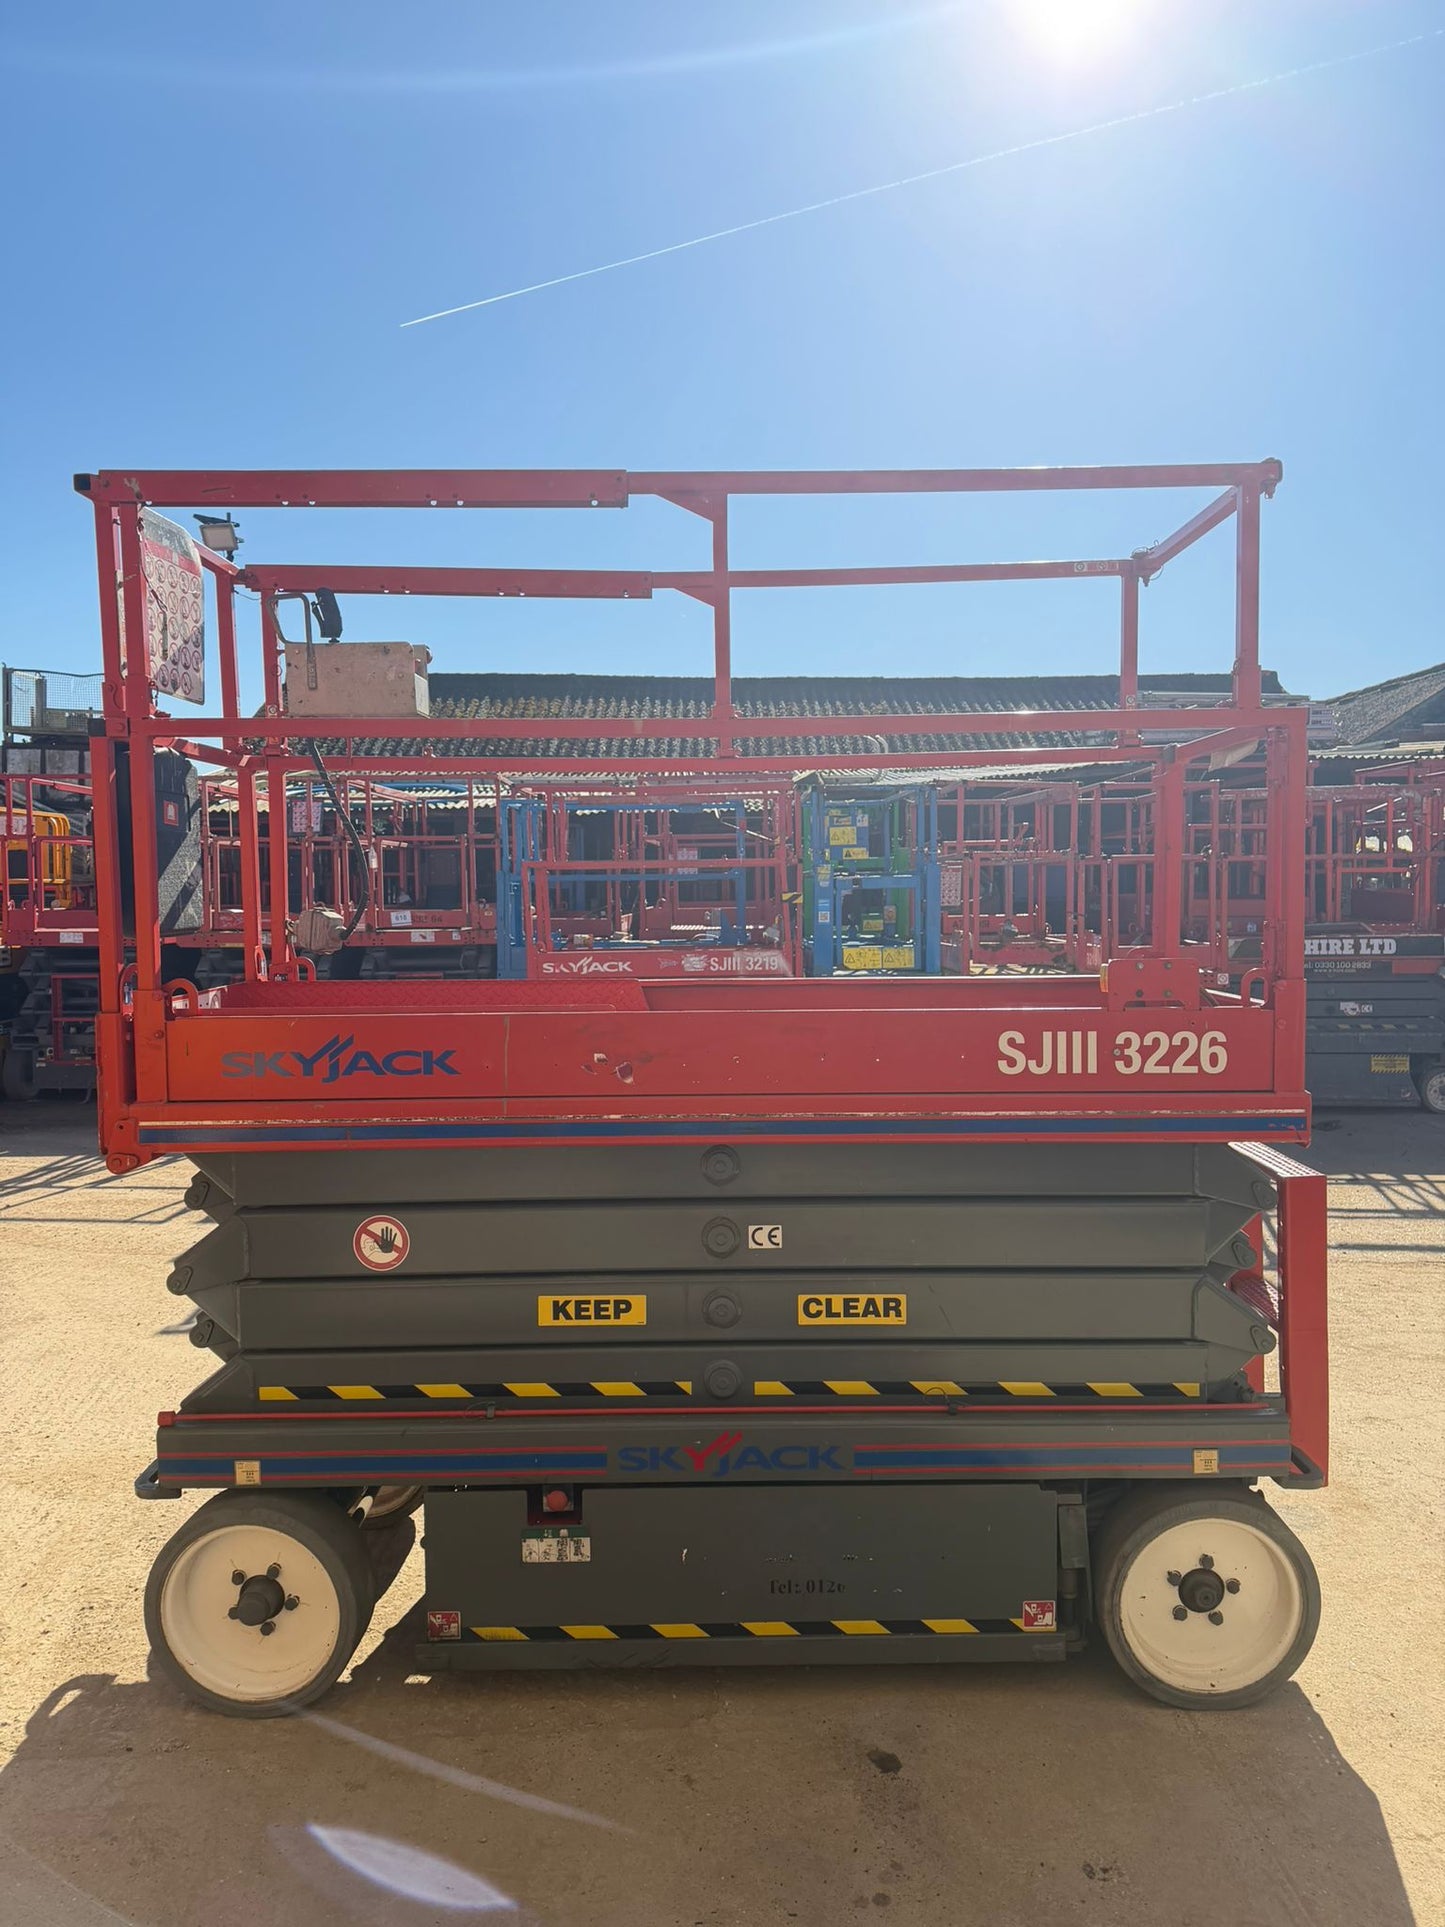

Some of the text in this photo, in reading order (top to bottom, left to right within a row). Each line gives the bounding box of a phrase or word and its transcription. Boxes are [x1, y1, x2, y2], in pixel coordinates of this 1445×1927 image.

[1304, 938, 1397, 955] HIRE LTD
[745, 956, 778, 971] 3219
[220, 1033, 462, 1083] SKYJACK
[997, 1030, 1228, 1075] SJIII 3226
[751, 1226, 780, 1247] CE
[552, 1299, 633, 1321] KEEP
[802, 1297, 902, 1319] CLEAR
[617, 1430, 847, 1477] SKYJACK
